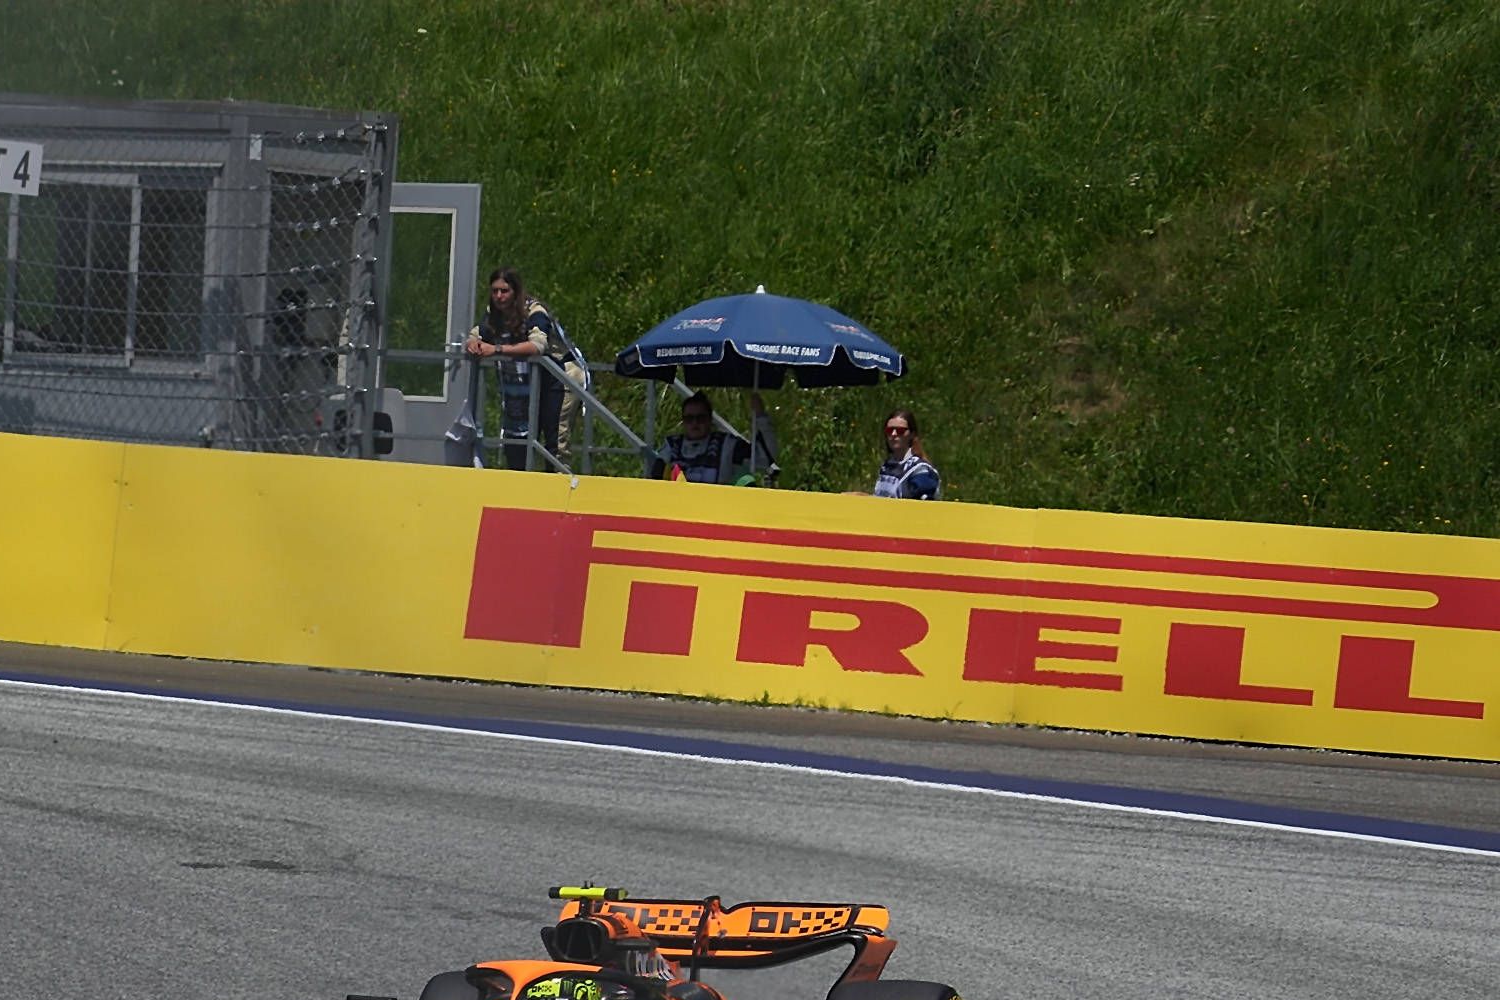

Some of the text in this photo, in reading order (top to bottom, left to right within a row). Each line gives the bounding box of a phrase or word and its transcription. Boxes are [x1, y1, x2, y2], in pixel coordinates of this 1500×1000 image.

[13, 150, 30, 188] 4
[745, 343, 820, 357] WELCOME RACE FANS
[463, 506, 1500, 718] PIRELL
